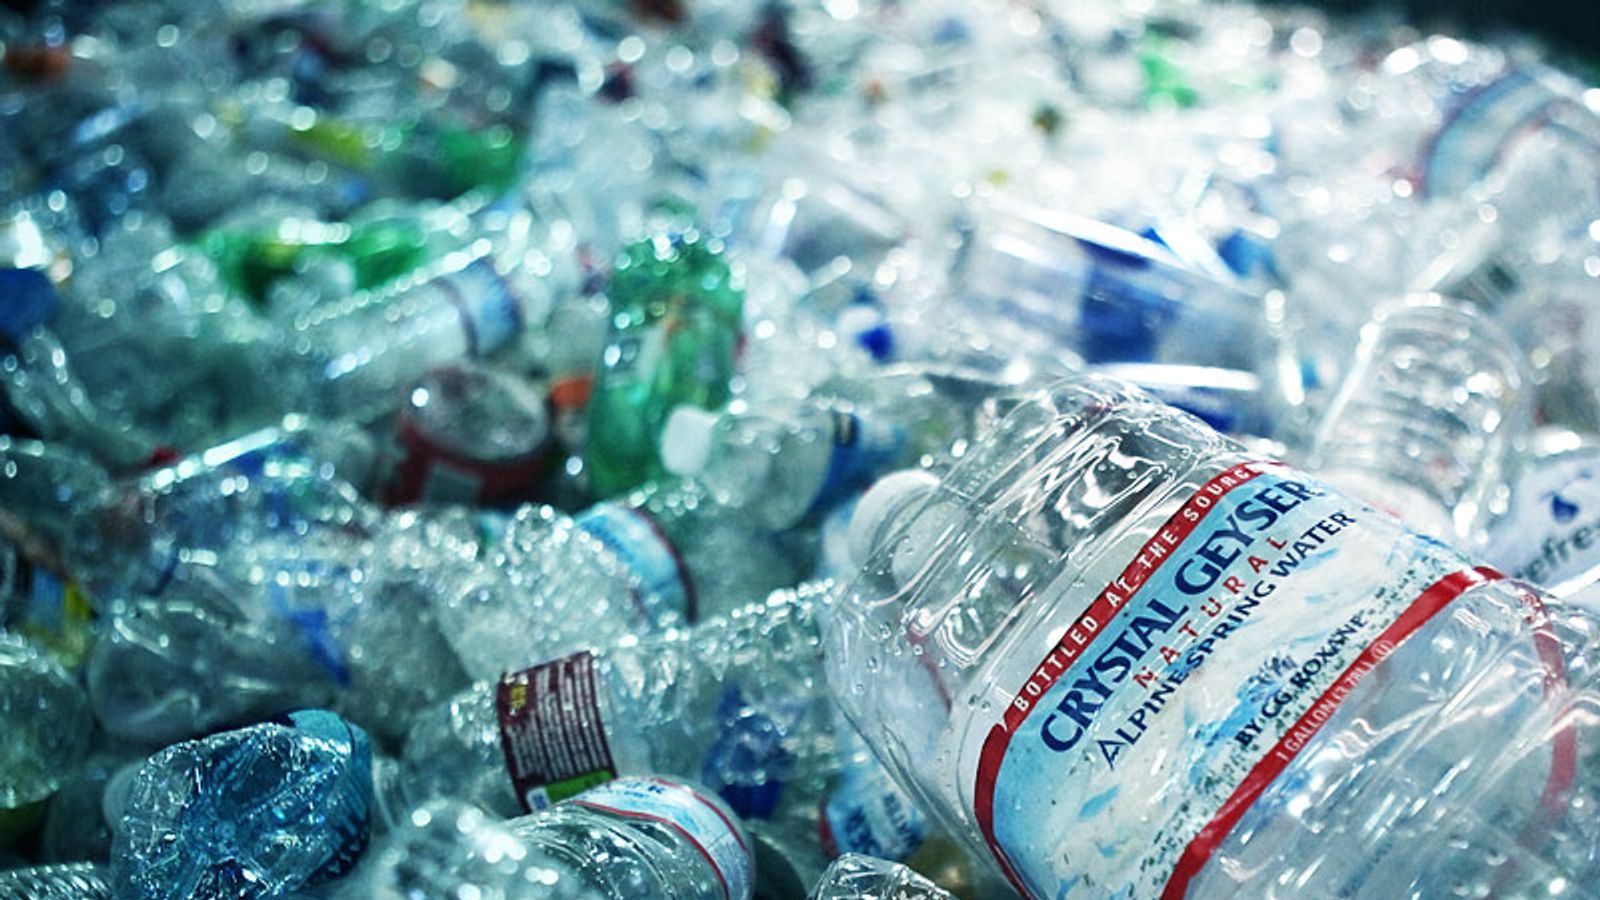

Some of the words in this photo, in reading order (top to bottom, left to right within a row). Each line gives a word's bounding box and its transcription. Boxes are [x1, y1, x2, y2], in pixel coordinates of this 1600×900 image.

[1015, 616, 1098, 713] BOTTLED
[1105, 577, 1139, 608] AT
[1137, 528, 1180, 569] THE
[1183, 464, 1260, 522] SOURC
[1040, 598, 1189, 752] CRYSTAL
[1174, 480, 1318, 595] GEYSER
[1096, 668, 1189, 770] ALPINE
[1191, 581, 1276, 669] SPRING
[1271, 509, 1356, 578] WATER
[1132, 537, 1288, 689] NATURAL
[1234, 717, 1263, 747] BY
[1290, 611, 1368, 689] ROXANE
[1276, 751, 1289, 762] 1
[1284, 699, 1337, 752] GALLON
